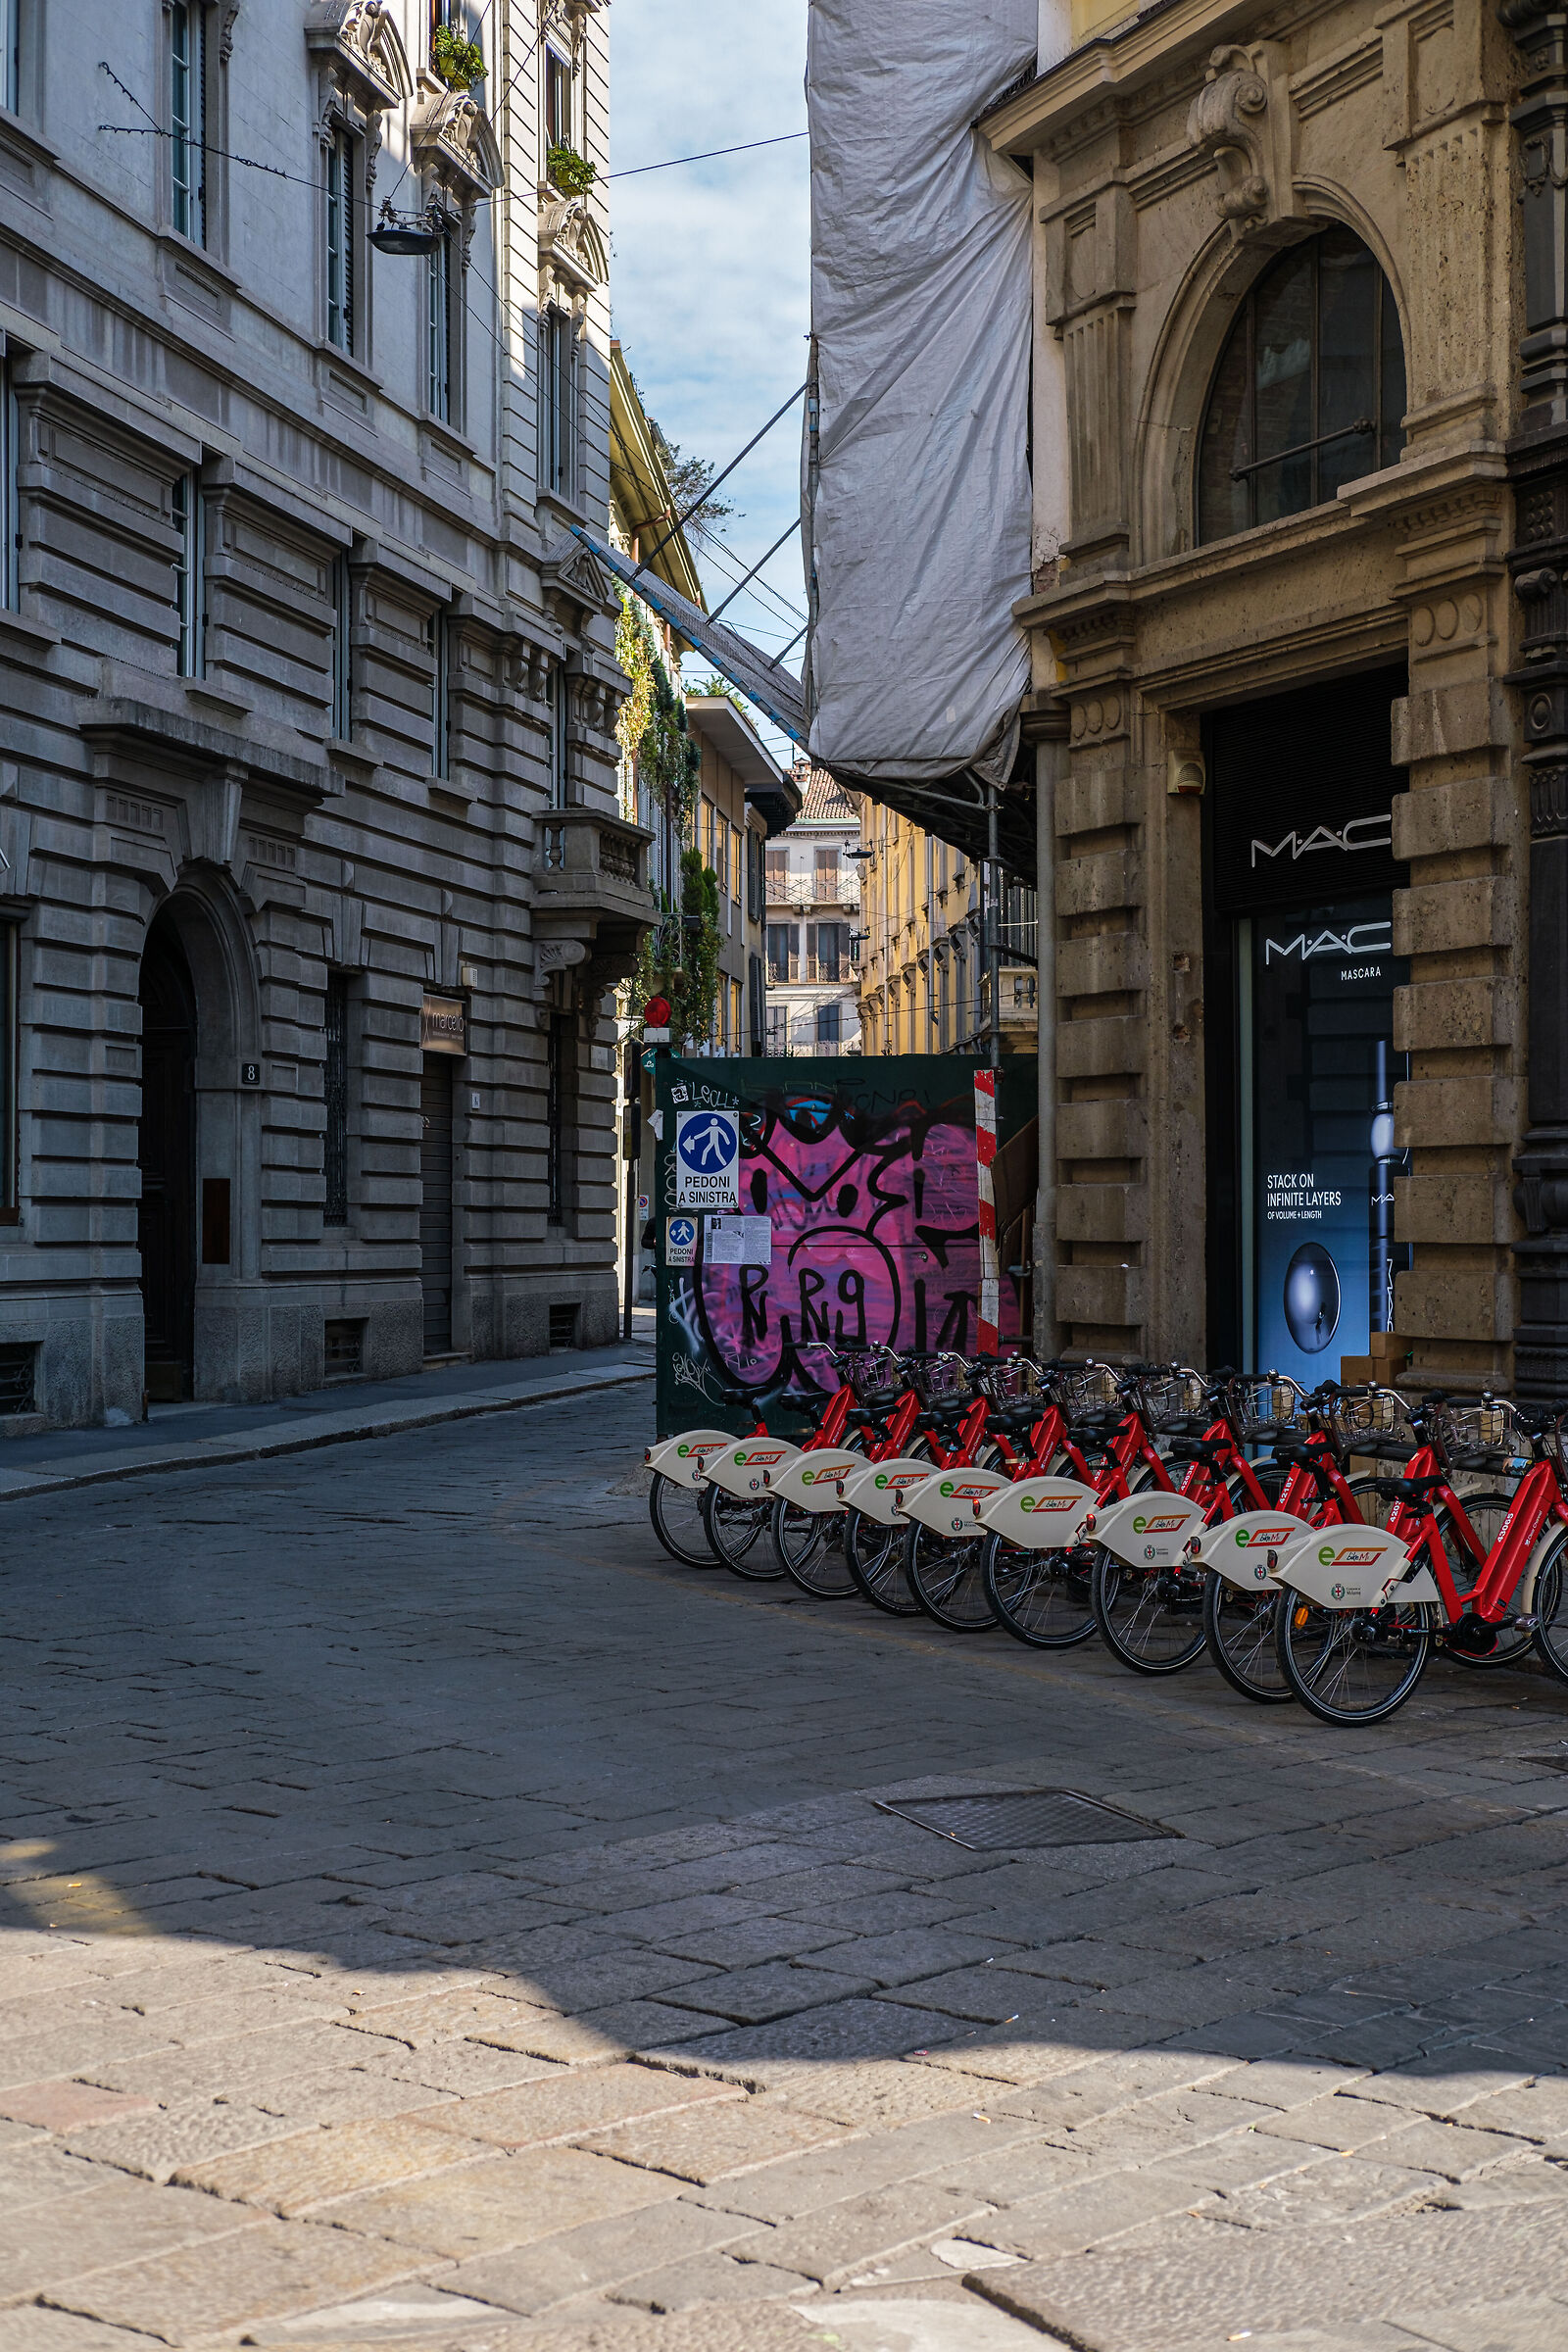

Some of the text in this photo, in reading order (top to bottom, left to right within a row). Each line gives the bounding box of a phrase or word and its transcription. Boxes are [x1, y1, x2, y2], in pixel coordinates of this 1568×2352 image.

[1341, 966, 1382, 981] MASCARA
[248, 1065, 255, 1080] 8
[685, 1176, 730, 1188] PEDONI
[1267, 1173, 1314, 1189] STACK ON
[678, 1191, 737, 1203] A SINISTRA
[1267, 1191, 1342, 1206] INFINITE LAYERS
[1372, 1193, 1395, 1205] MA
[1267, 1211, 1275, 1220] OF
[1275, 1210, 1298, 1220] VOLUME
[1300, 1210, 1322, 1219] LENGTH
[1279, 1476, 1294, 1504] 42187
[1390, 1495, 1401, 1522] 4203
[1497, 1513, 1514, 1543] 43065
